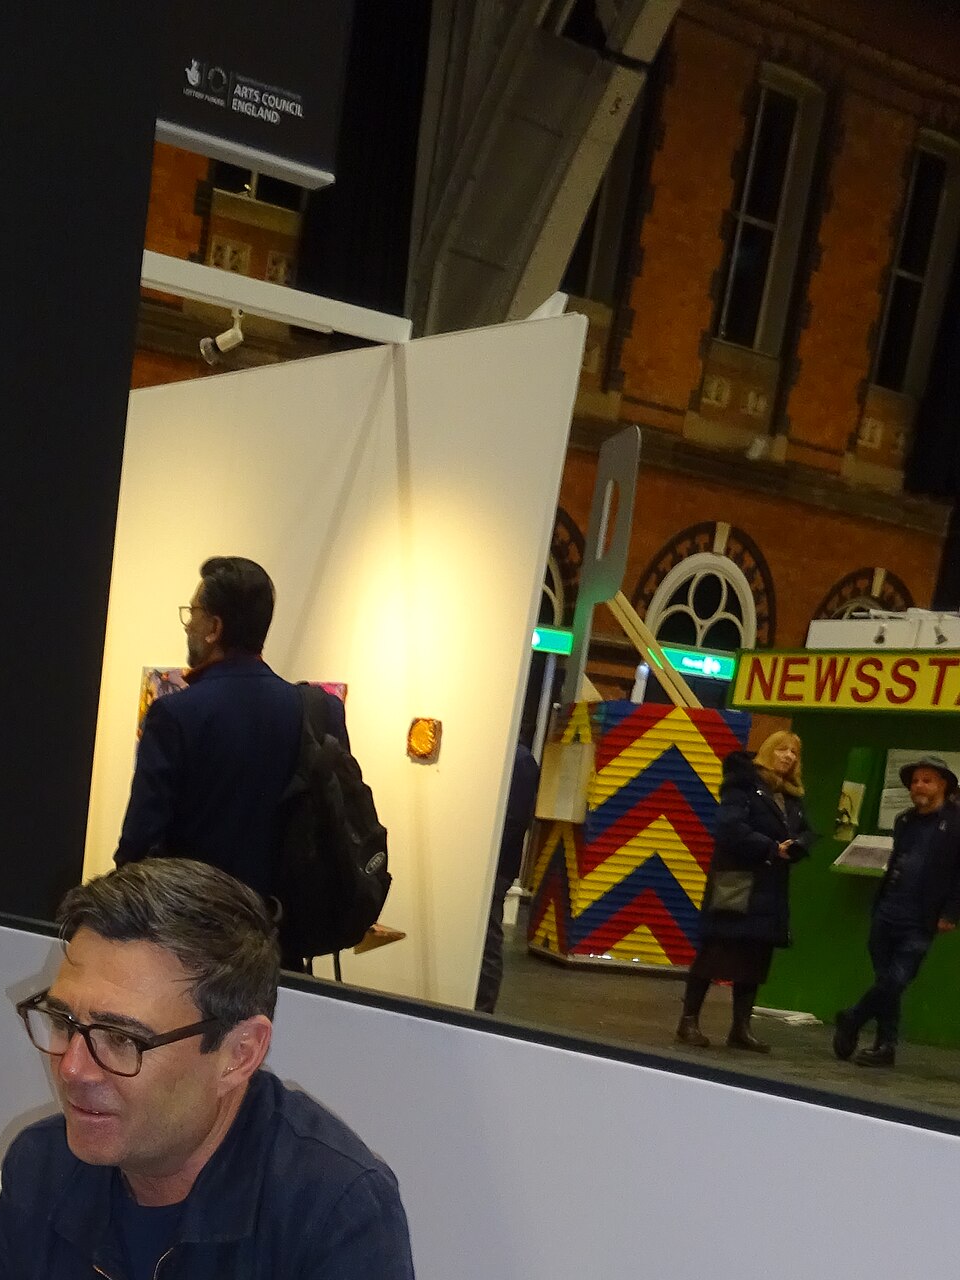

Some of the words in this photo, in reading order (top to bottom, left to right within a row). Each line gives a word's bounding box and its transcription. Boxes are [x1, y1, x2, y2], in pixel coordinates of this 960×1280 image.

[232, 98, 281, 124] ENGLAND
[234, 84, 260, 103] ARTS
[262, 93, 303, 117] COUNCIL
[745, 656, 960, 706] NEWSST
